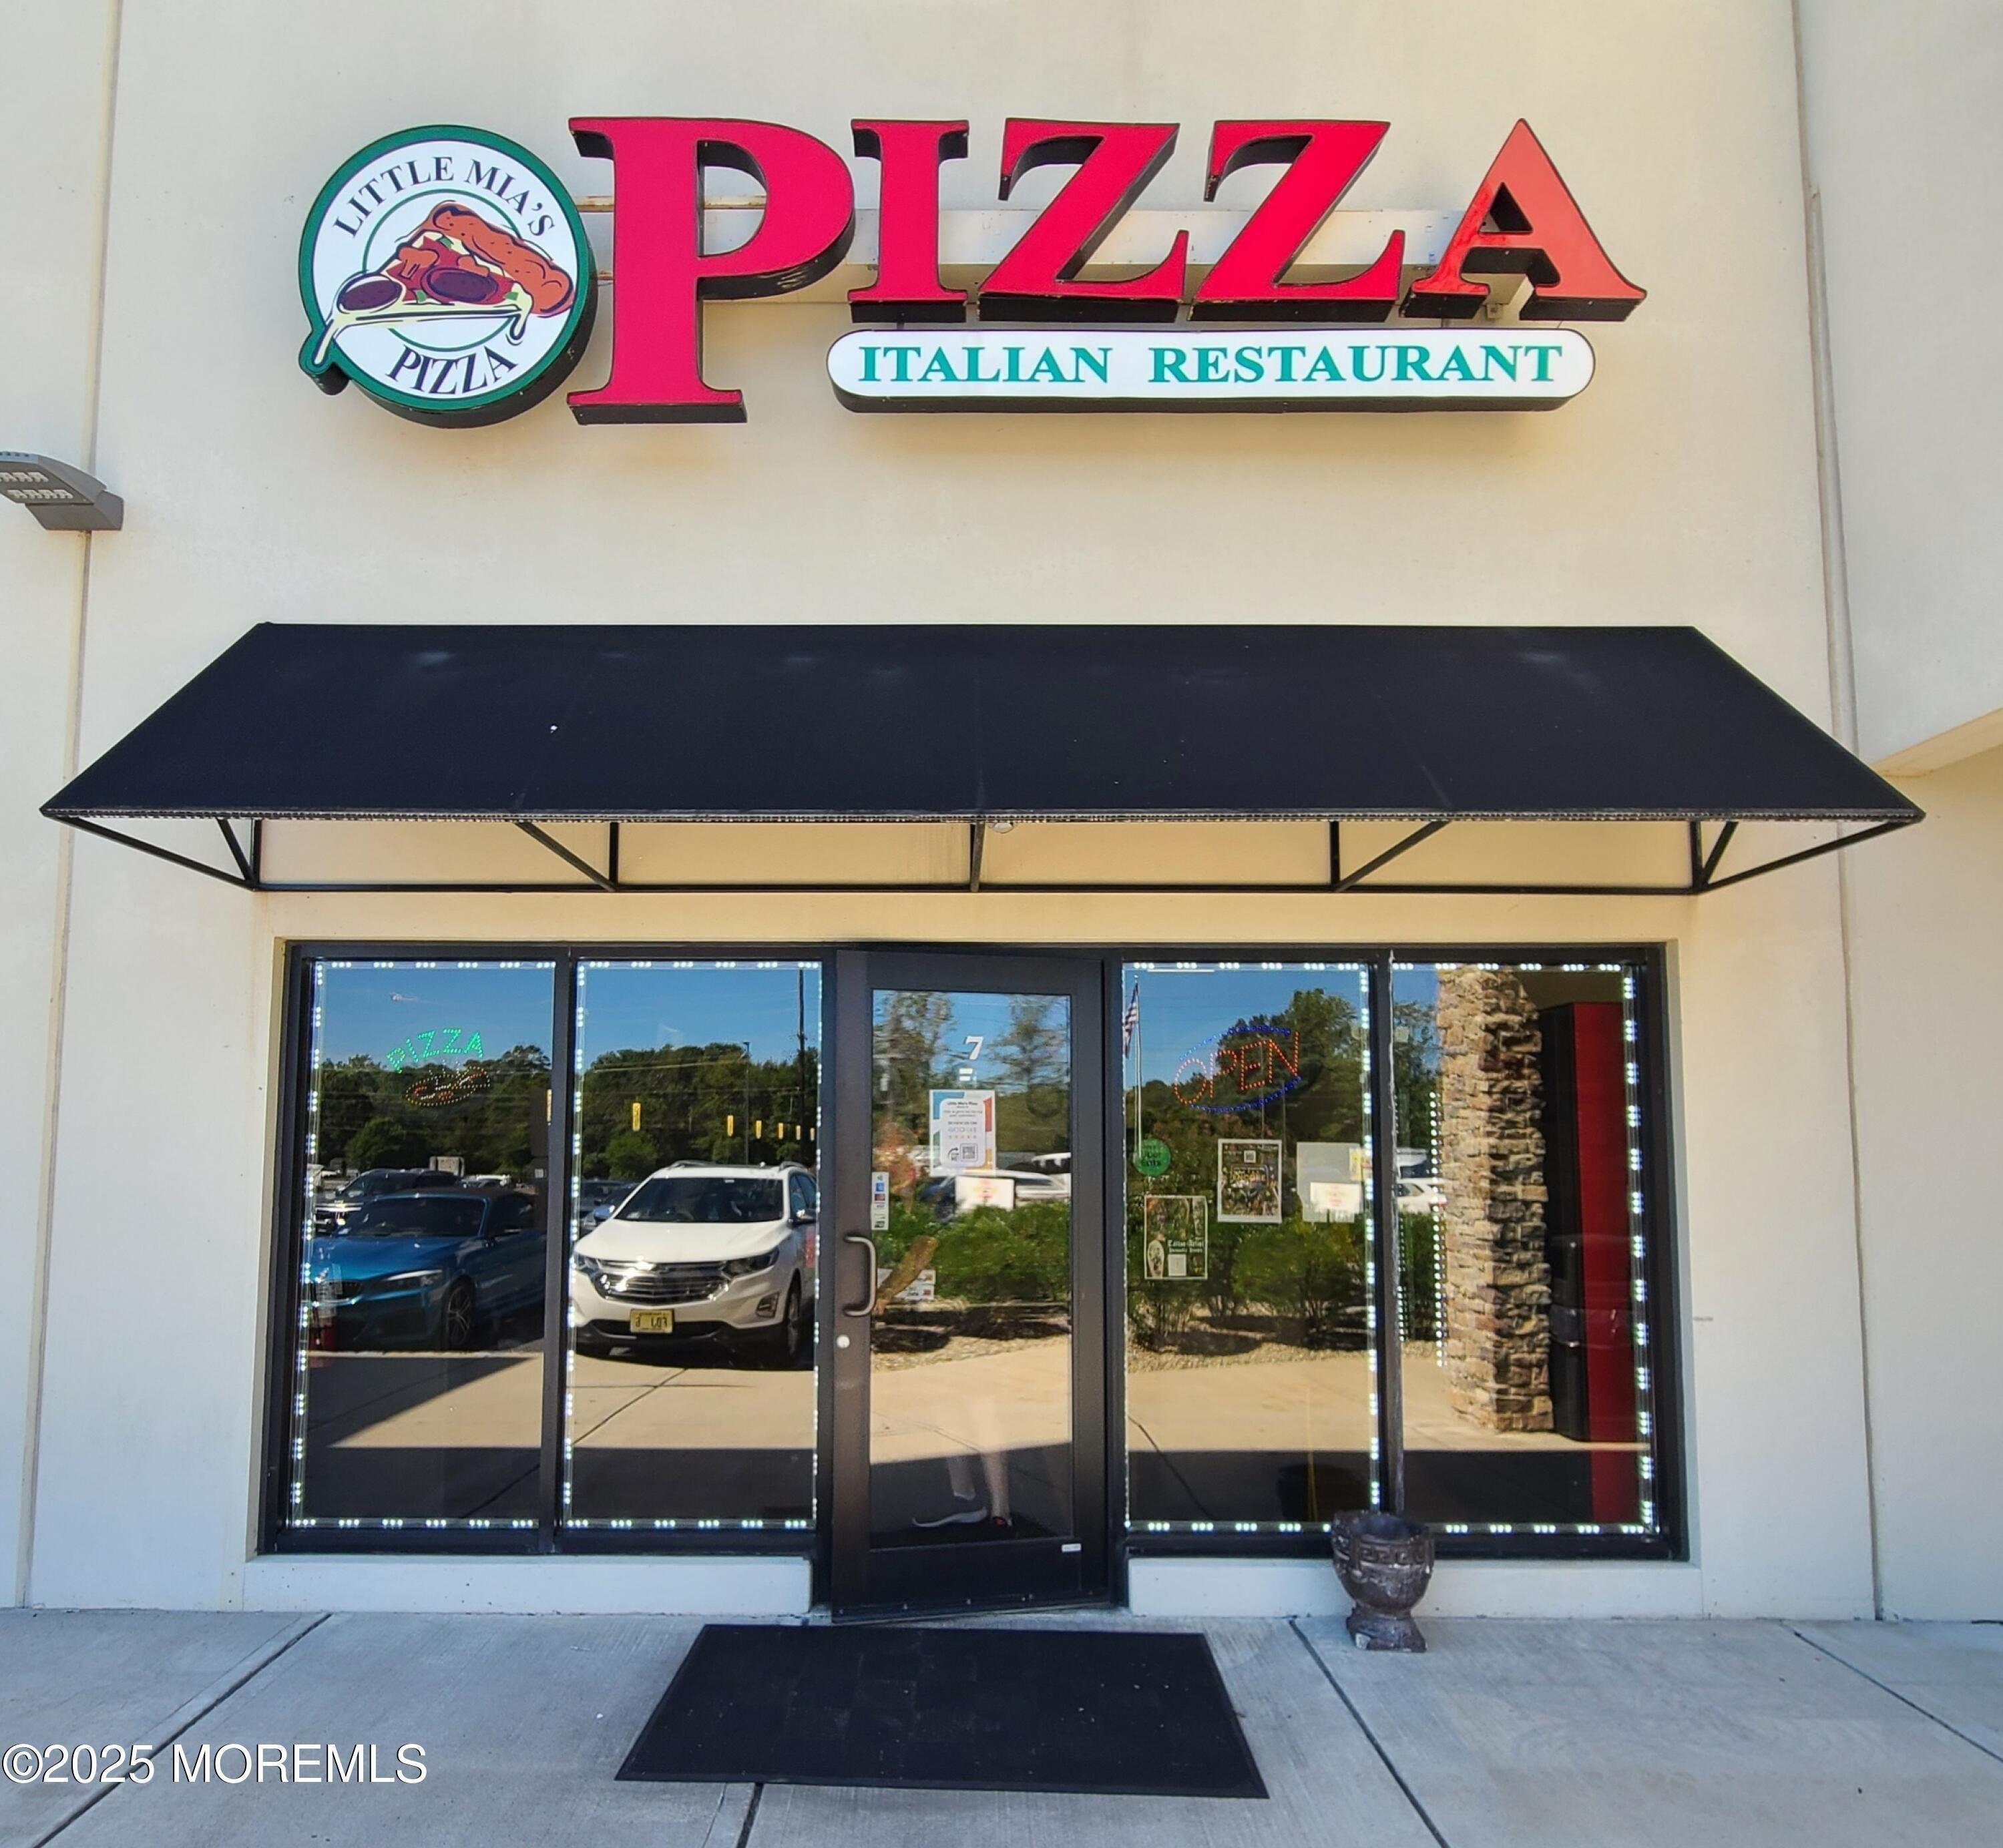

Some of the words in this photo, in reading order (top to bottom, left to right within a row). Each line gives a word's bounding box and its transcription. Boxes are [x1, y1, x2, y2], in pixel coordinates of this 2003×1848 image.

[333, 156, 454, 238] LITTLE
[465, 159, 555, 236] MIA'S
[568, 117, 1648, 408] PIZZA
[385, 344, 519, 395] PIZZA
[858, 346, 1113, 383] ITALIAN
[1148, 345, 1563, 383] RESTAURANT
[387, 1028, 483, 1074] PIZZA
[965, 1035, 984, 1060] 7
[1174, 1031, 1300, 1105] OPEN
